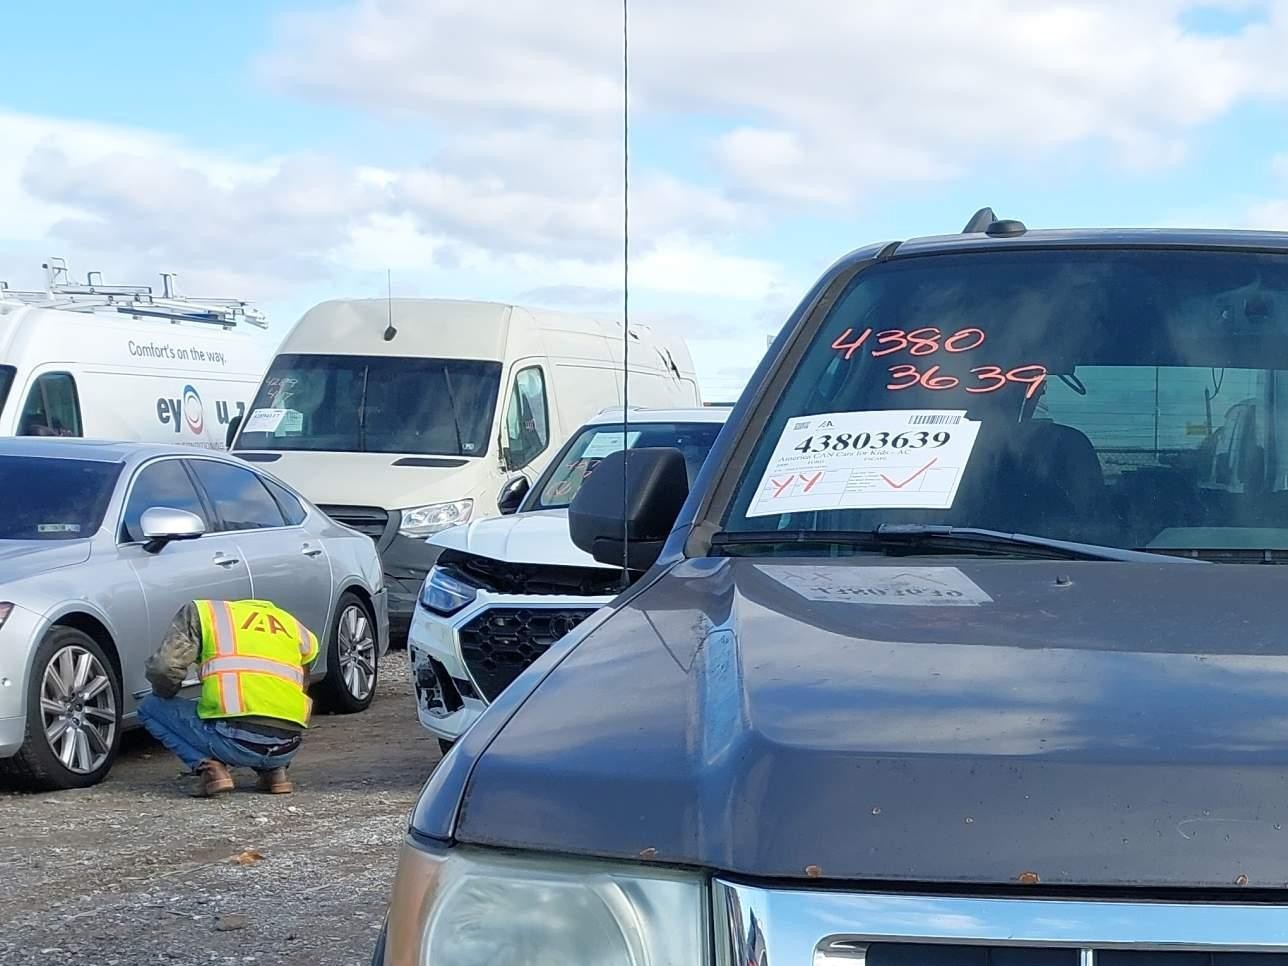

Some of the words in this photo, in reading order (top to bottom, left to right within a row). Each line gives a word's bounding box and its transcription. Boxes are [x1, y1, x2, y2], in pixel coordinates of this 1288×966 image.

[128, 340, 176, 359] Comfort's
[177, 348, 189, 360] on
[190, 346, 206, 361] the
[206, 351, 227, 366] way.
[831, 327, 985, 359] 4380
[886, 365, 1047, 399] 3639
[794, 431, 951, 453] 43803639
[778, 453, 812, 462] America
[812, 452, 834, 460] CAN
